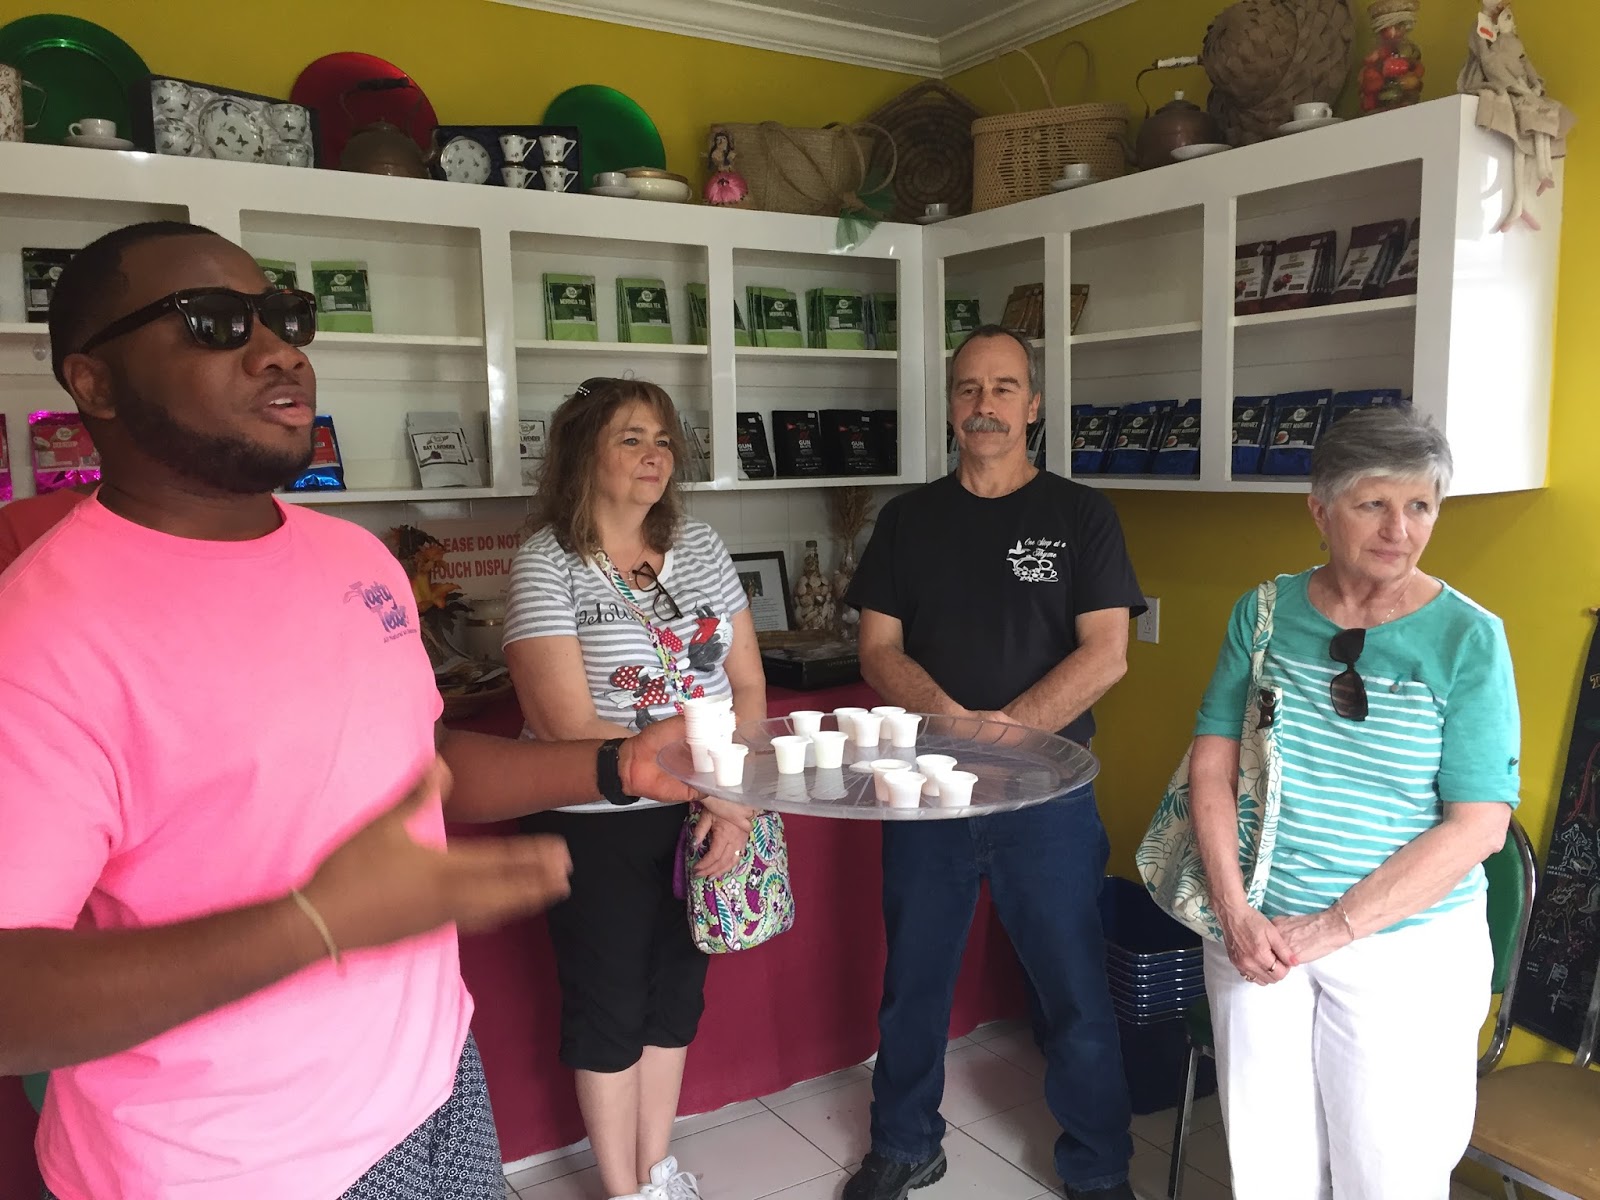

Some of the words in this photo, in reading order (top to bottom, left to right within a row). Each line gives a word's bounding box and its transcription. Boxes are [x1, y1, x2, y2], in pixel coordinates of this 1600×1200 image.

[477, 535, 495, 551] DO
[497, 533, 520, 550] NOT
[348, 581, 398, 610] Tasty
